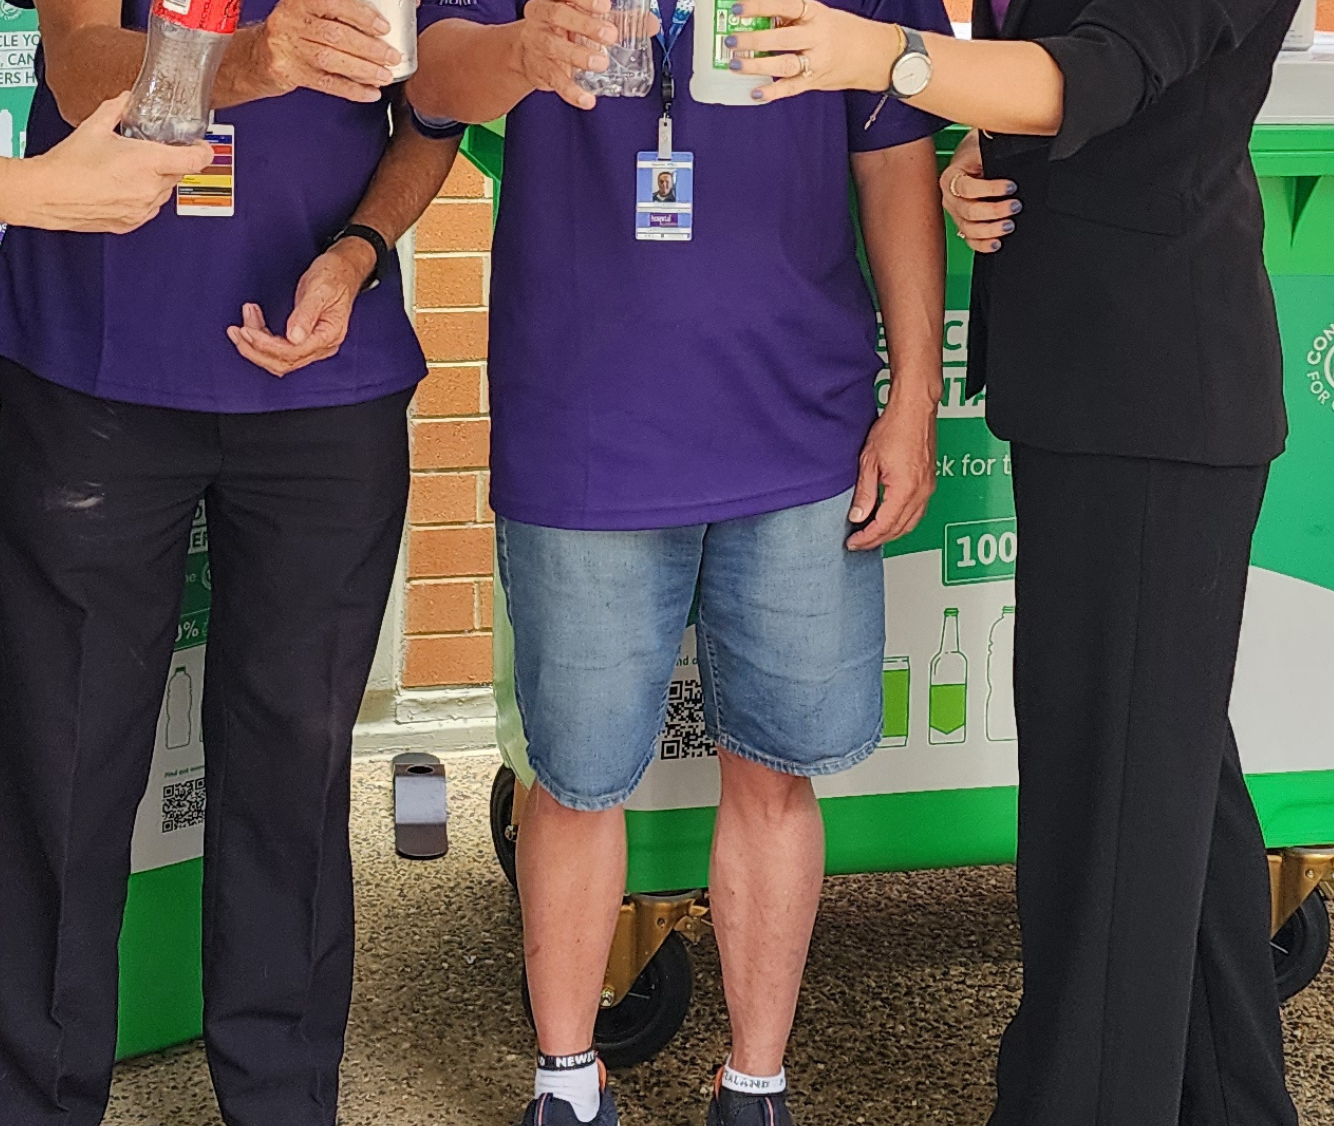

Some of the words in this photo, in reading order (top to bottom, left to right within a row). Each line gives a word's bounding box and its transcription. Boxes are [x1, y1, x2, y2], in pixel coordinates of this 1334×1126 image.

[23, 34, 41, 47] YO
[7, 54, 35, 66] CAN
[1307, 371, 1331, 404] FOR
[961, 454, 997, 476] for
[957, 532, 1017, 568] 100
